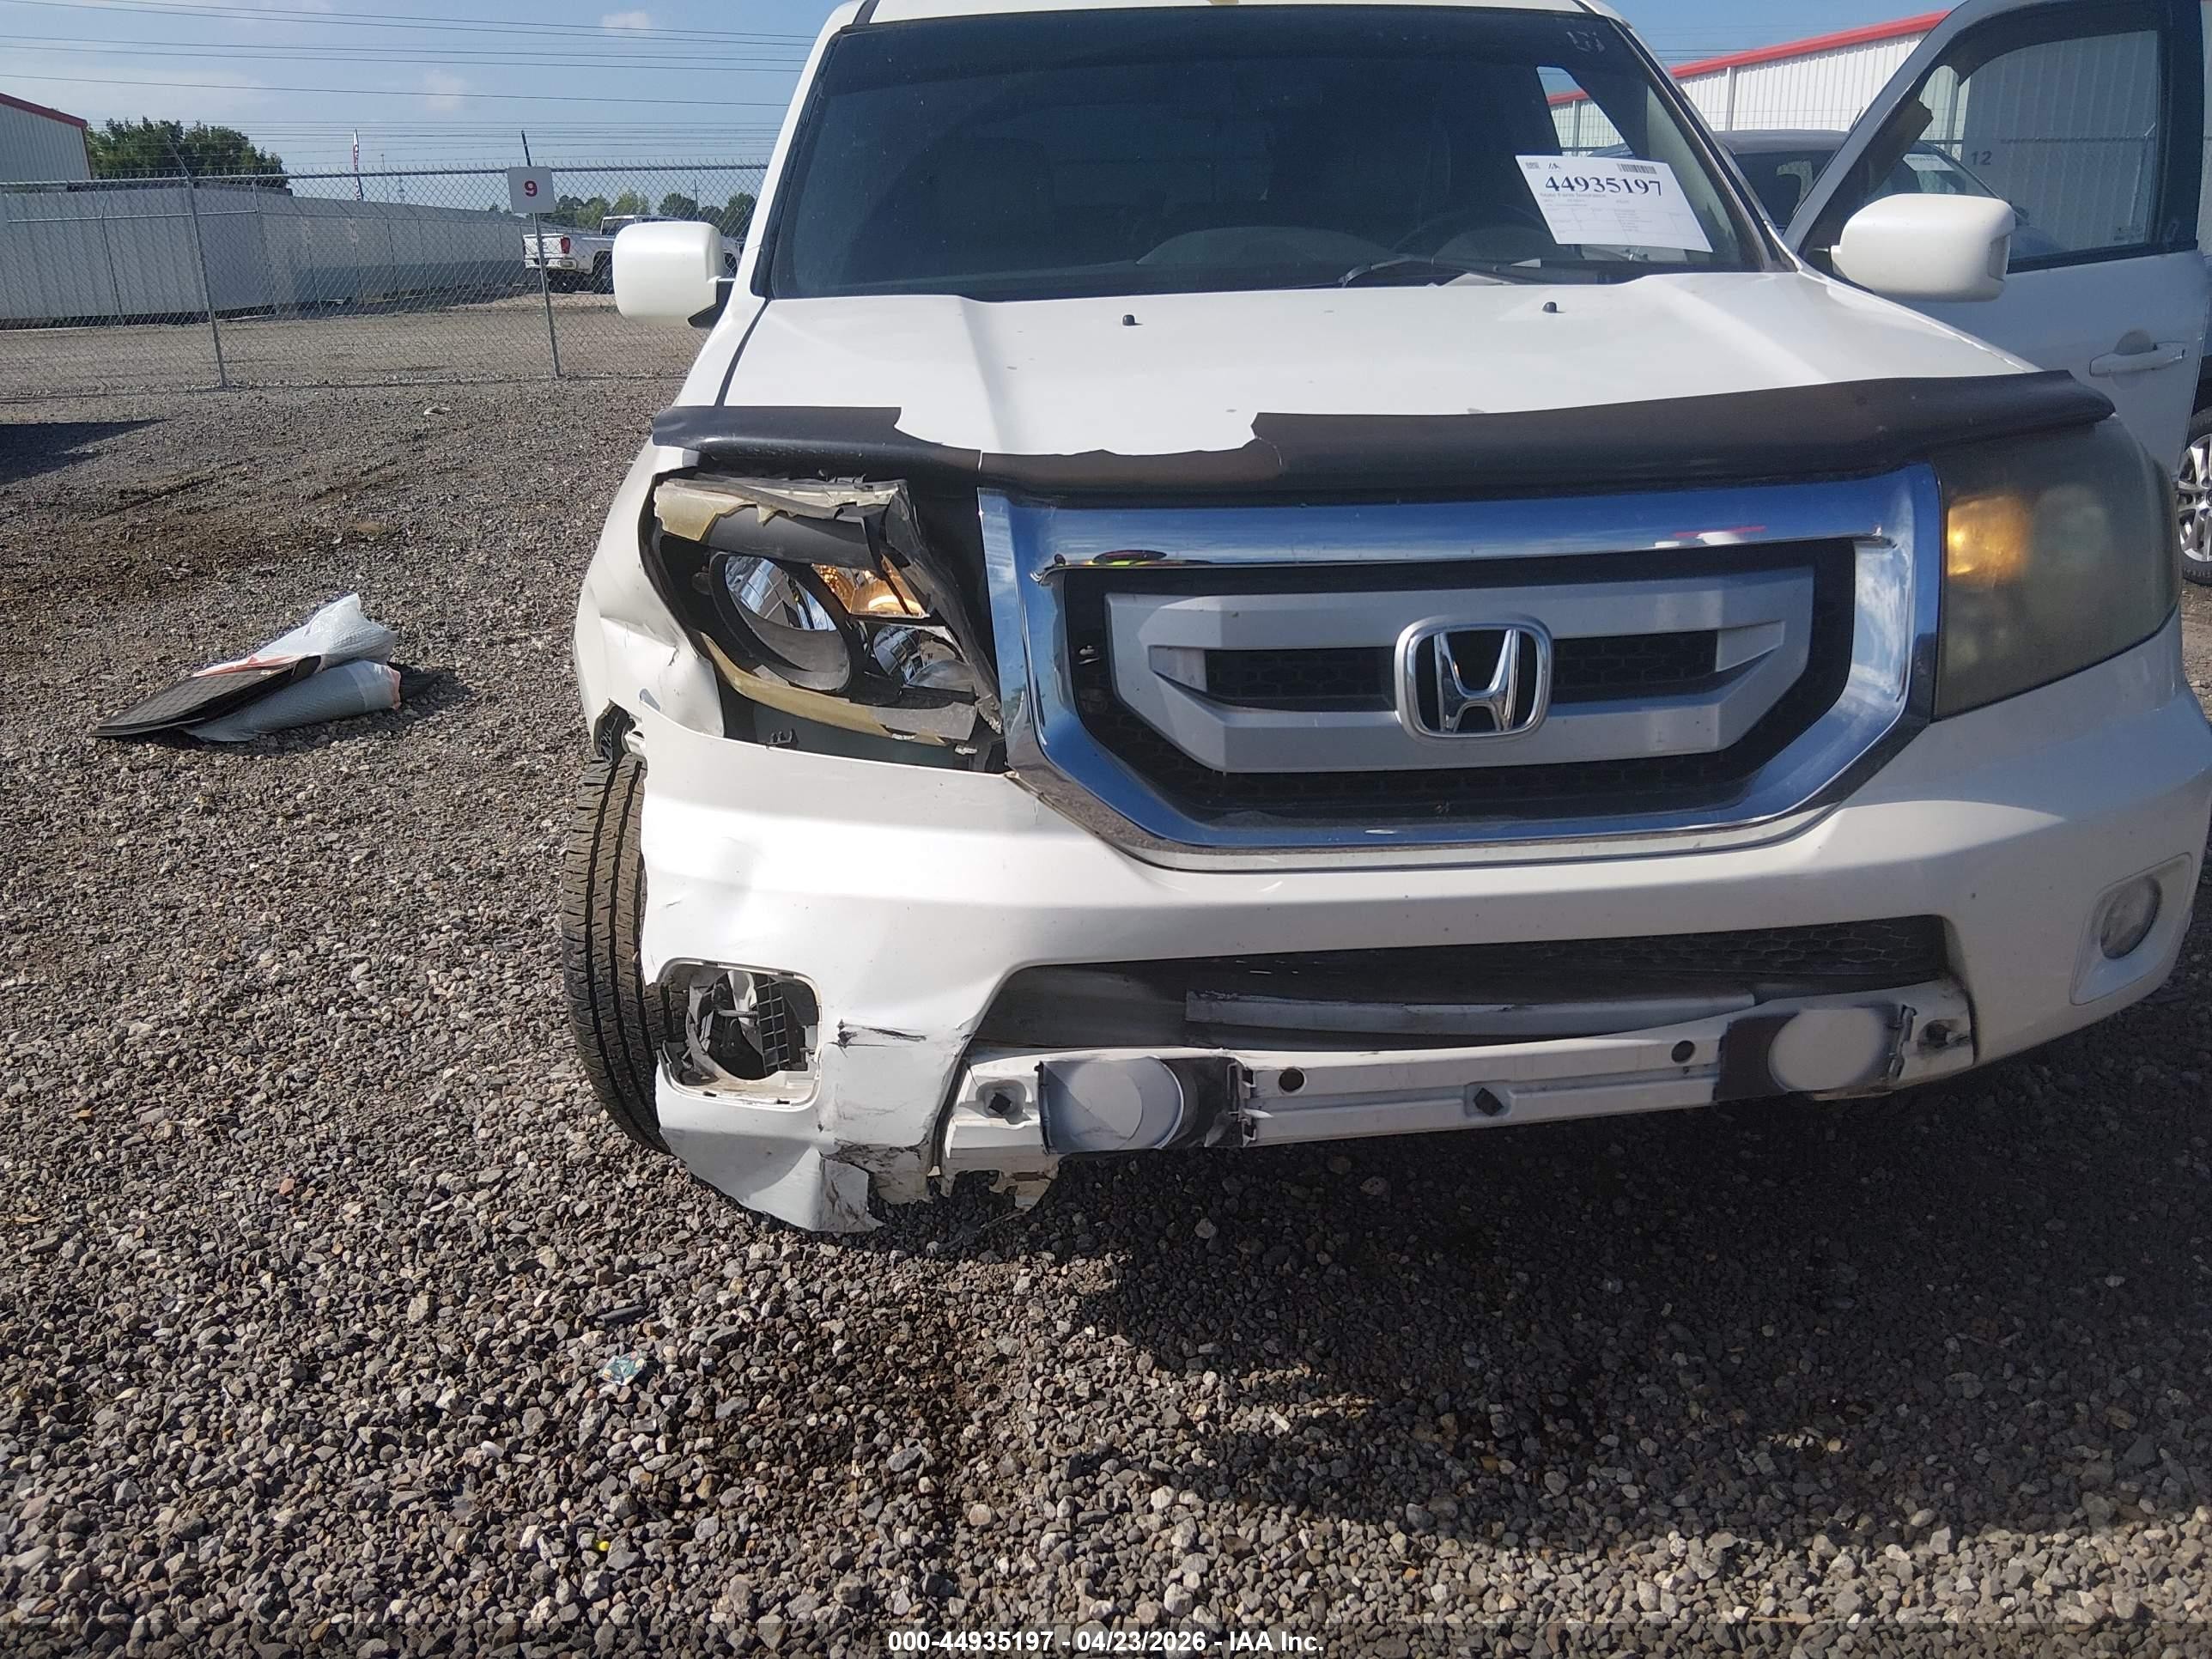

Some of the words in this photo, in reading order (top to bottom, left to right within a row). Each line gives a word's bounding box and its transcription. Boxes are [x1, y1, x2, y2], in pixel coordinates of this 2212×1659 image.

[1971, 150, 1992, 165] 12
[524, 180, 538, 198] 9
[1545, 176, 1662, 197] 44935197
